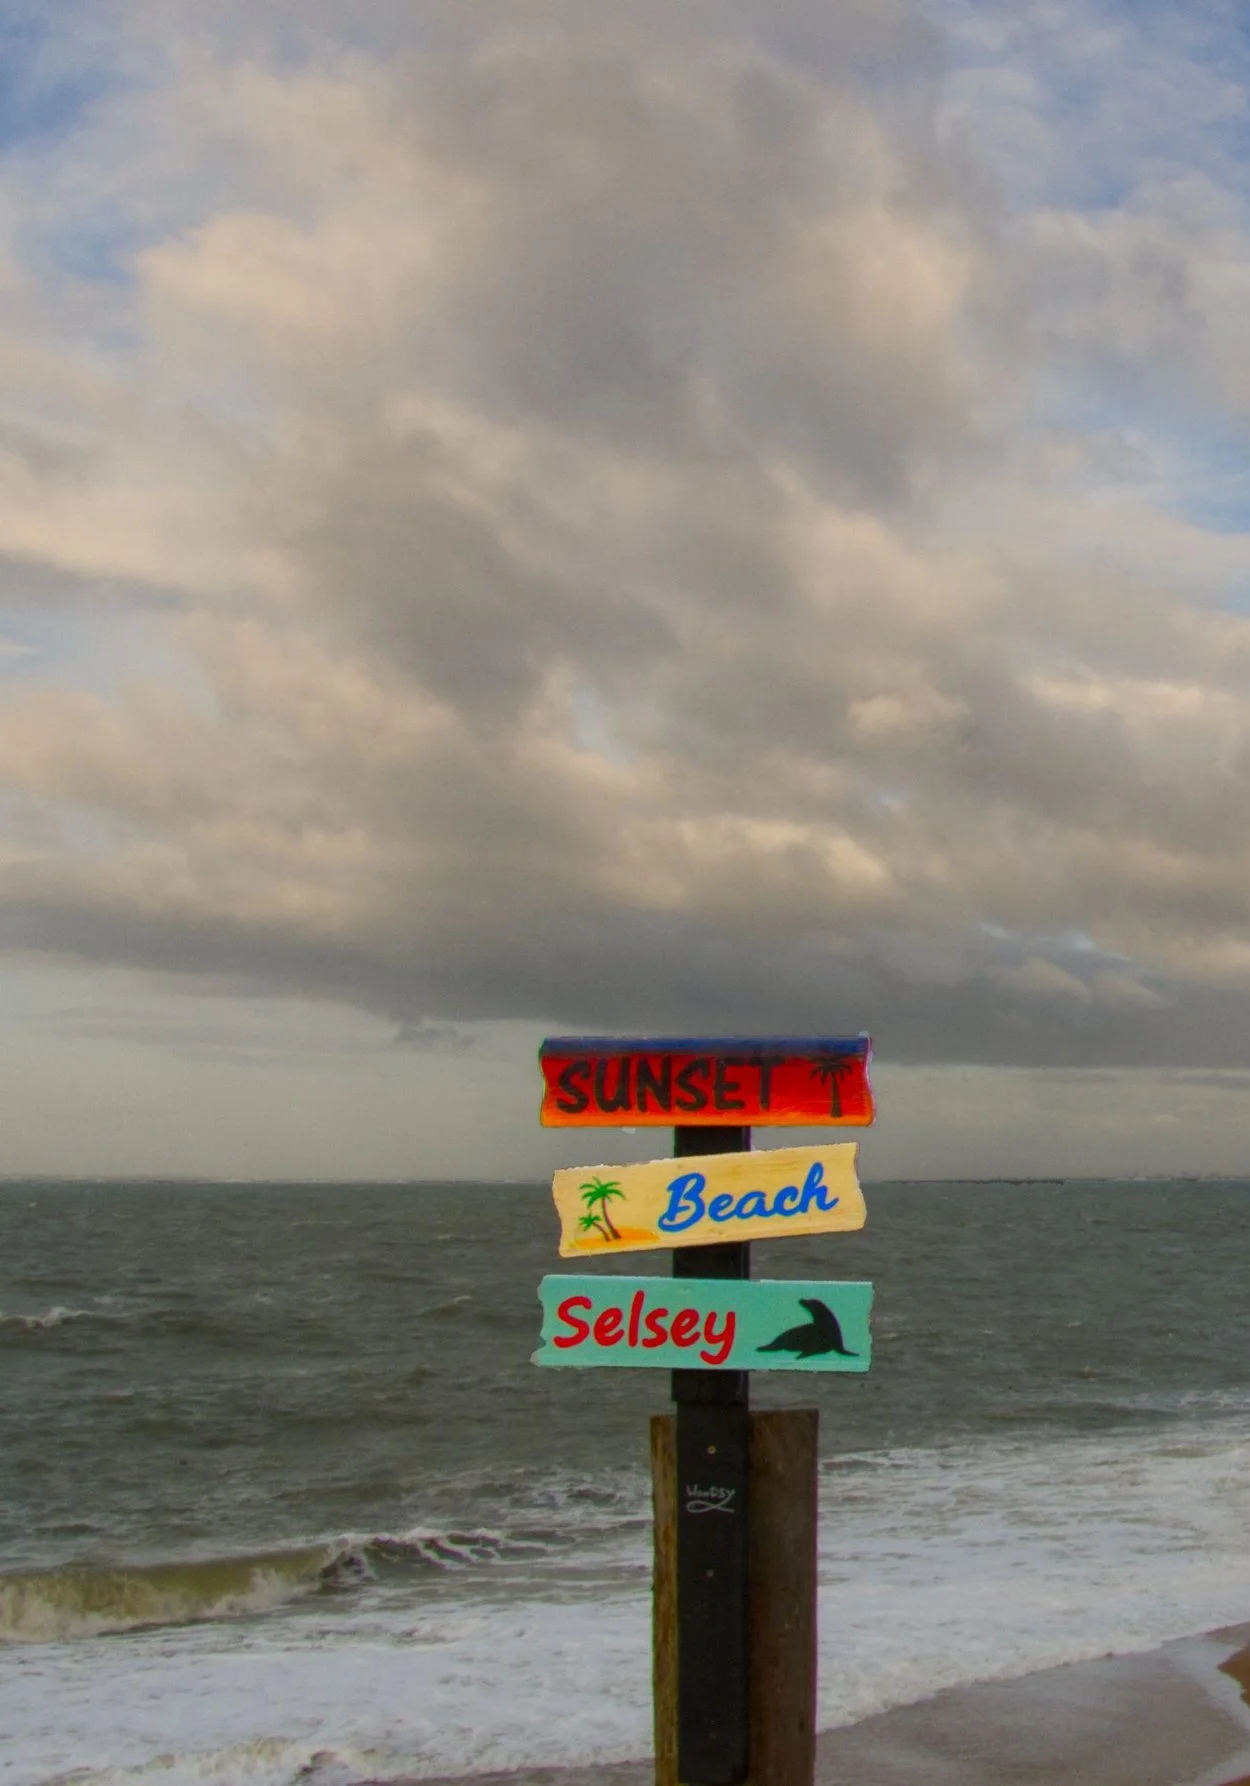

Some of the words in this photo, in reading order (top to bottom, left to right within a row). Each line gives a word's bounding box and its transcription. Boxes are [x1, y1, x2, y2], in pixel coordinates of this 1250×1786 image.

[556, 1056, 785, 1114] SUNSET
[657, 1162, 839, 1232] Beach
[553, 1290, 736, 1365] Selsey
